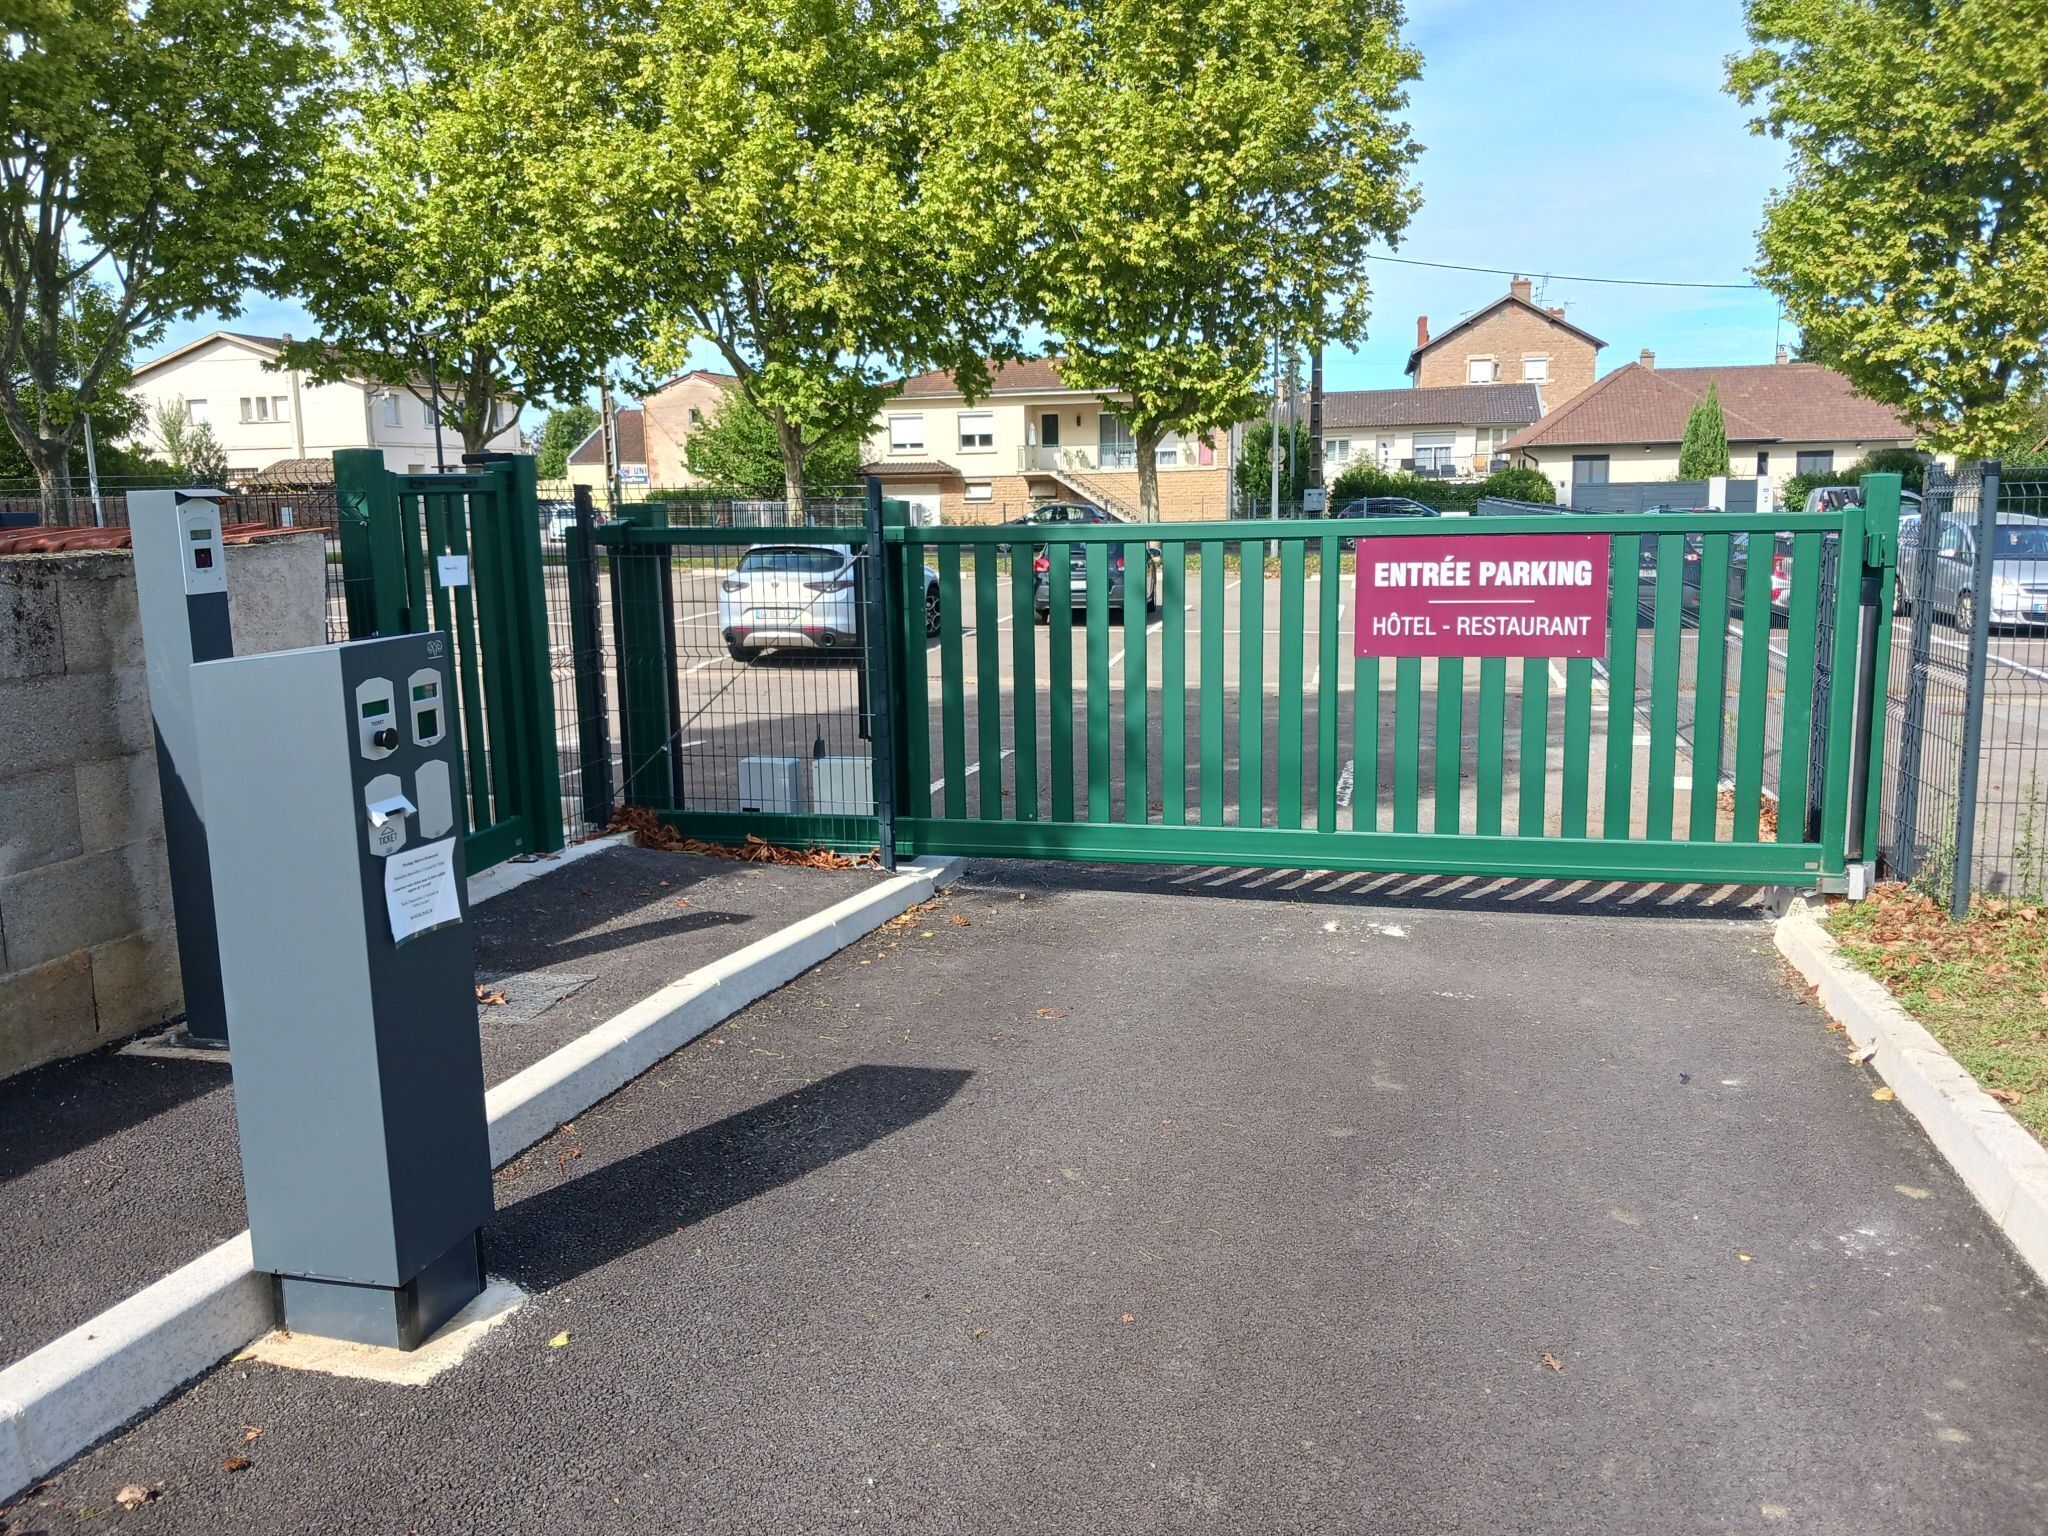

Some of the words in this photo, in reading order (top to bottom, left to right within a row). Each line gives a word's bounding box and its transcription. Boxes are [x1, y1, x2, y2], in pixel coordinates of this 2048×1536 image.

[1374, 555, 1471, 587] ENTRÉE
[1479, 560, 1592, 587] PARKING
[1373, 612, 1436, 636] HÔTEL
[1457, 616, 1592, 636] RESTAURANT
[378, 833, 398, 846] TICKET
